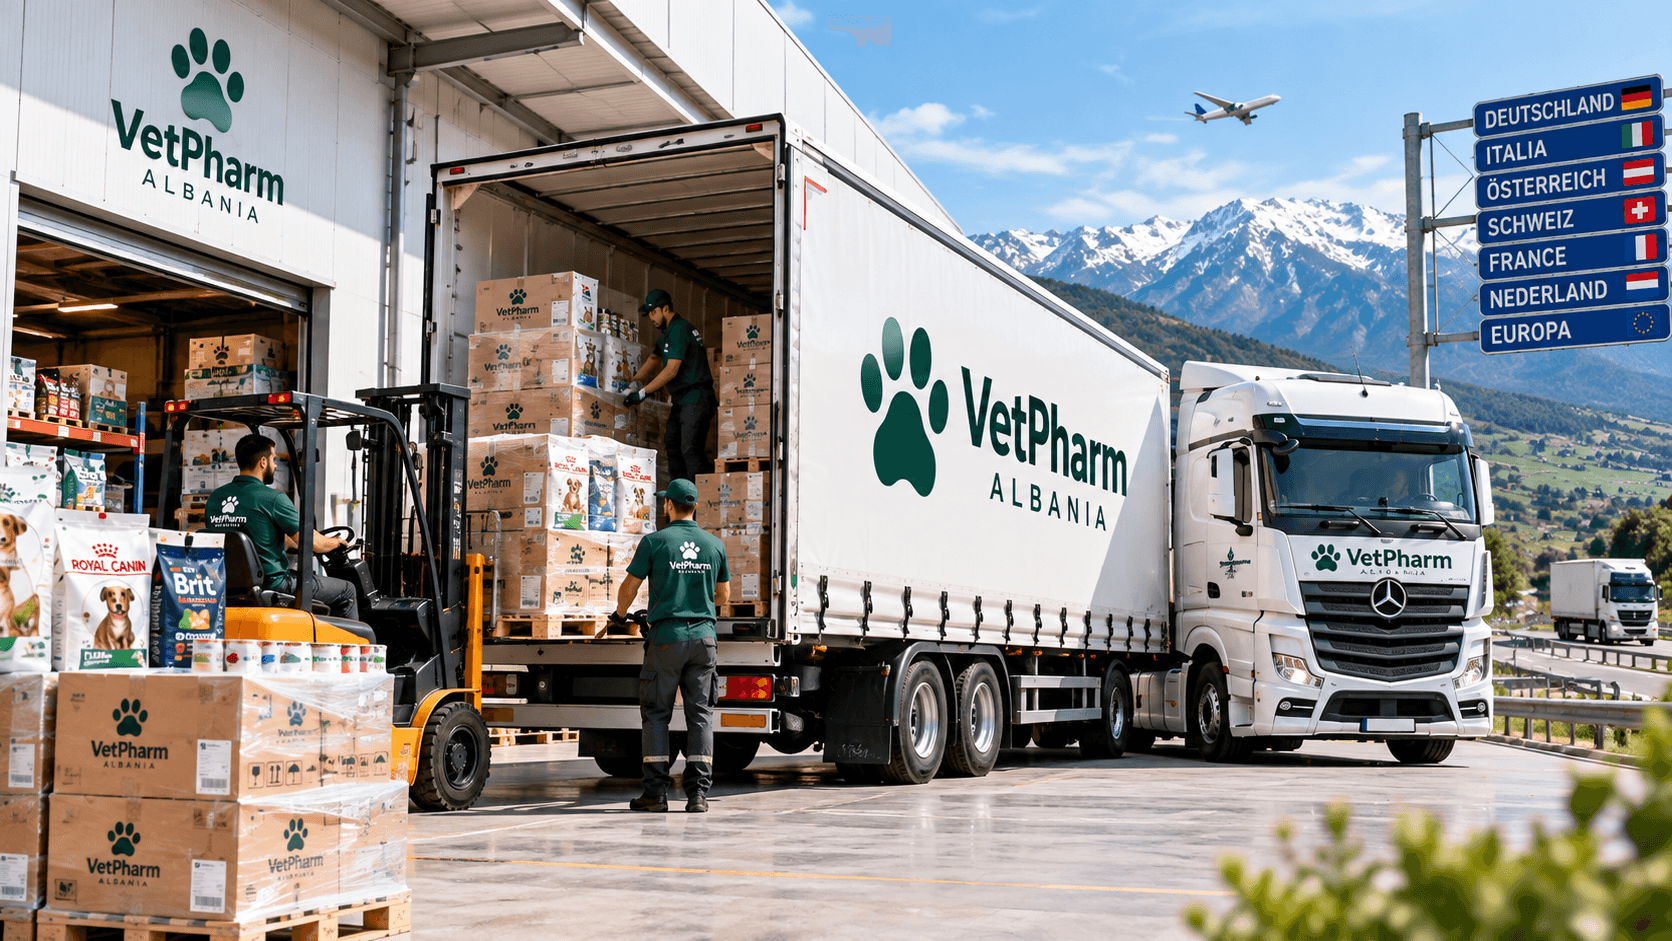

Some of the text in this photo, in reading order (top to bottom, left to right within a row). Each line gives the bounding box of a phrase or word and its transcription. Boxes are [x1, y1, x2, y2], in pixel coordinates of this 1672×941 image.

[1485, 92, 1615, 129] DEUTSCHLAND
[111, 98, 285, 206] VetPharm
[1486, 139, 1547, 165] ITALIA
[1487, 167, 1606, 200] ÖSTERREICH
[142, 168, 259, 224] ALBANIA
[1488, 209, 1574, 237] SCHWEIZ
[1489, 246, 1567, 272] FRANCE
[1490, 280, 1608, 309] NEDERLAND
[496, 306, 539, 316] VetPharm
[1491, 320, 1572, 344] EUROPA
[960, 365, 1128, 497] VetPharm
[467, 477, 511, 490] VetPharm
[989, 472, 1107, 531] ALBANIA
[71, 559, 146, 573] ROYAL CANIN
[668, 560, 712, 570] VetPharm
[1346, 548, 1452, 569] VetPharm
[173, 572, 217, 596] Brit
[91, 740, 169, 760] VetPharm
[103, 761, 155, 769] ALBANIA
[86, 857, 160, 878] VetPharm
[267, 855, 324, 873] VetPharm
[98, 878, 148, 887] ALBANIA
